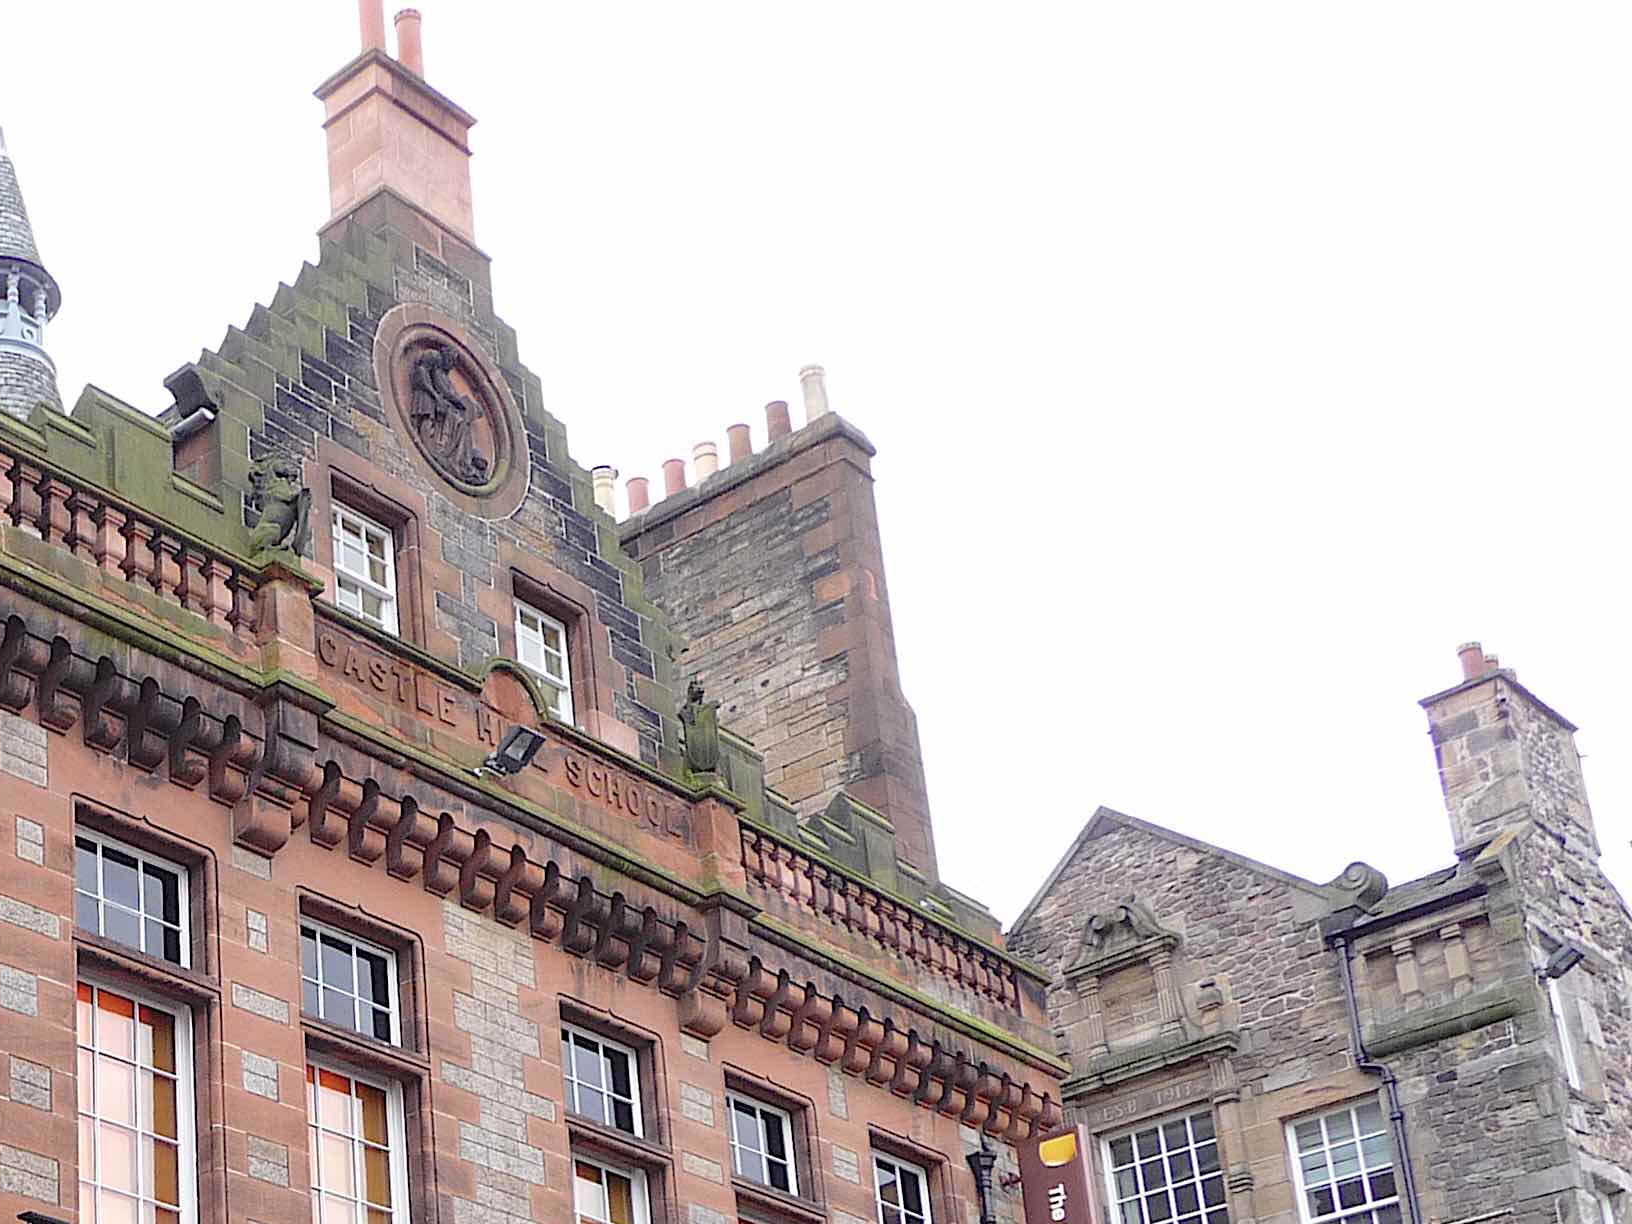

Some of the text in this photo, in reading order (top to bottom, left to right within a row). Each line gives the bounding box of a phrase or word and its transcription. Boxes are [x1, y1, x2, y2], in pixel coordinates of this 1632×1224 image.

[319, 633, 682, 839] CASTLE HI SCHOOL
[1048, 1183, 1066, 1222] The
